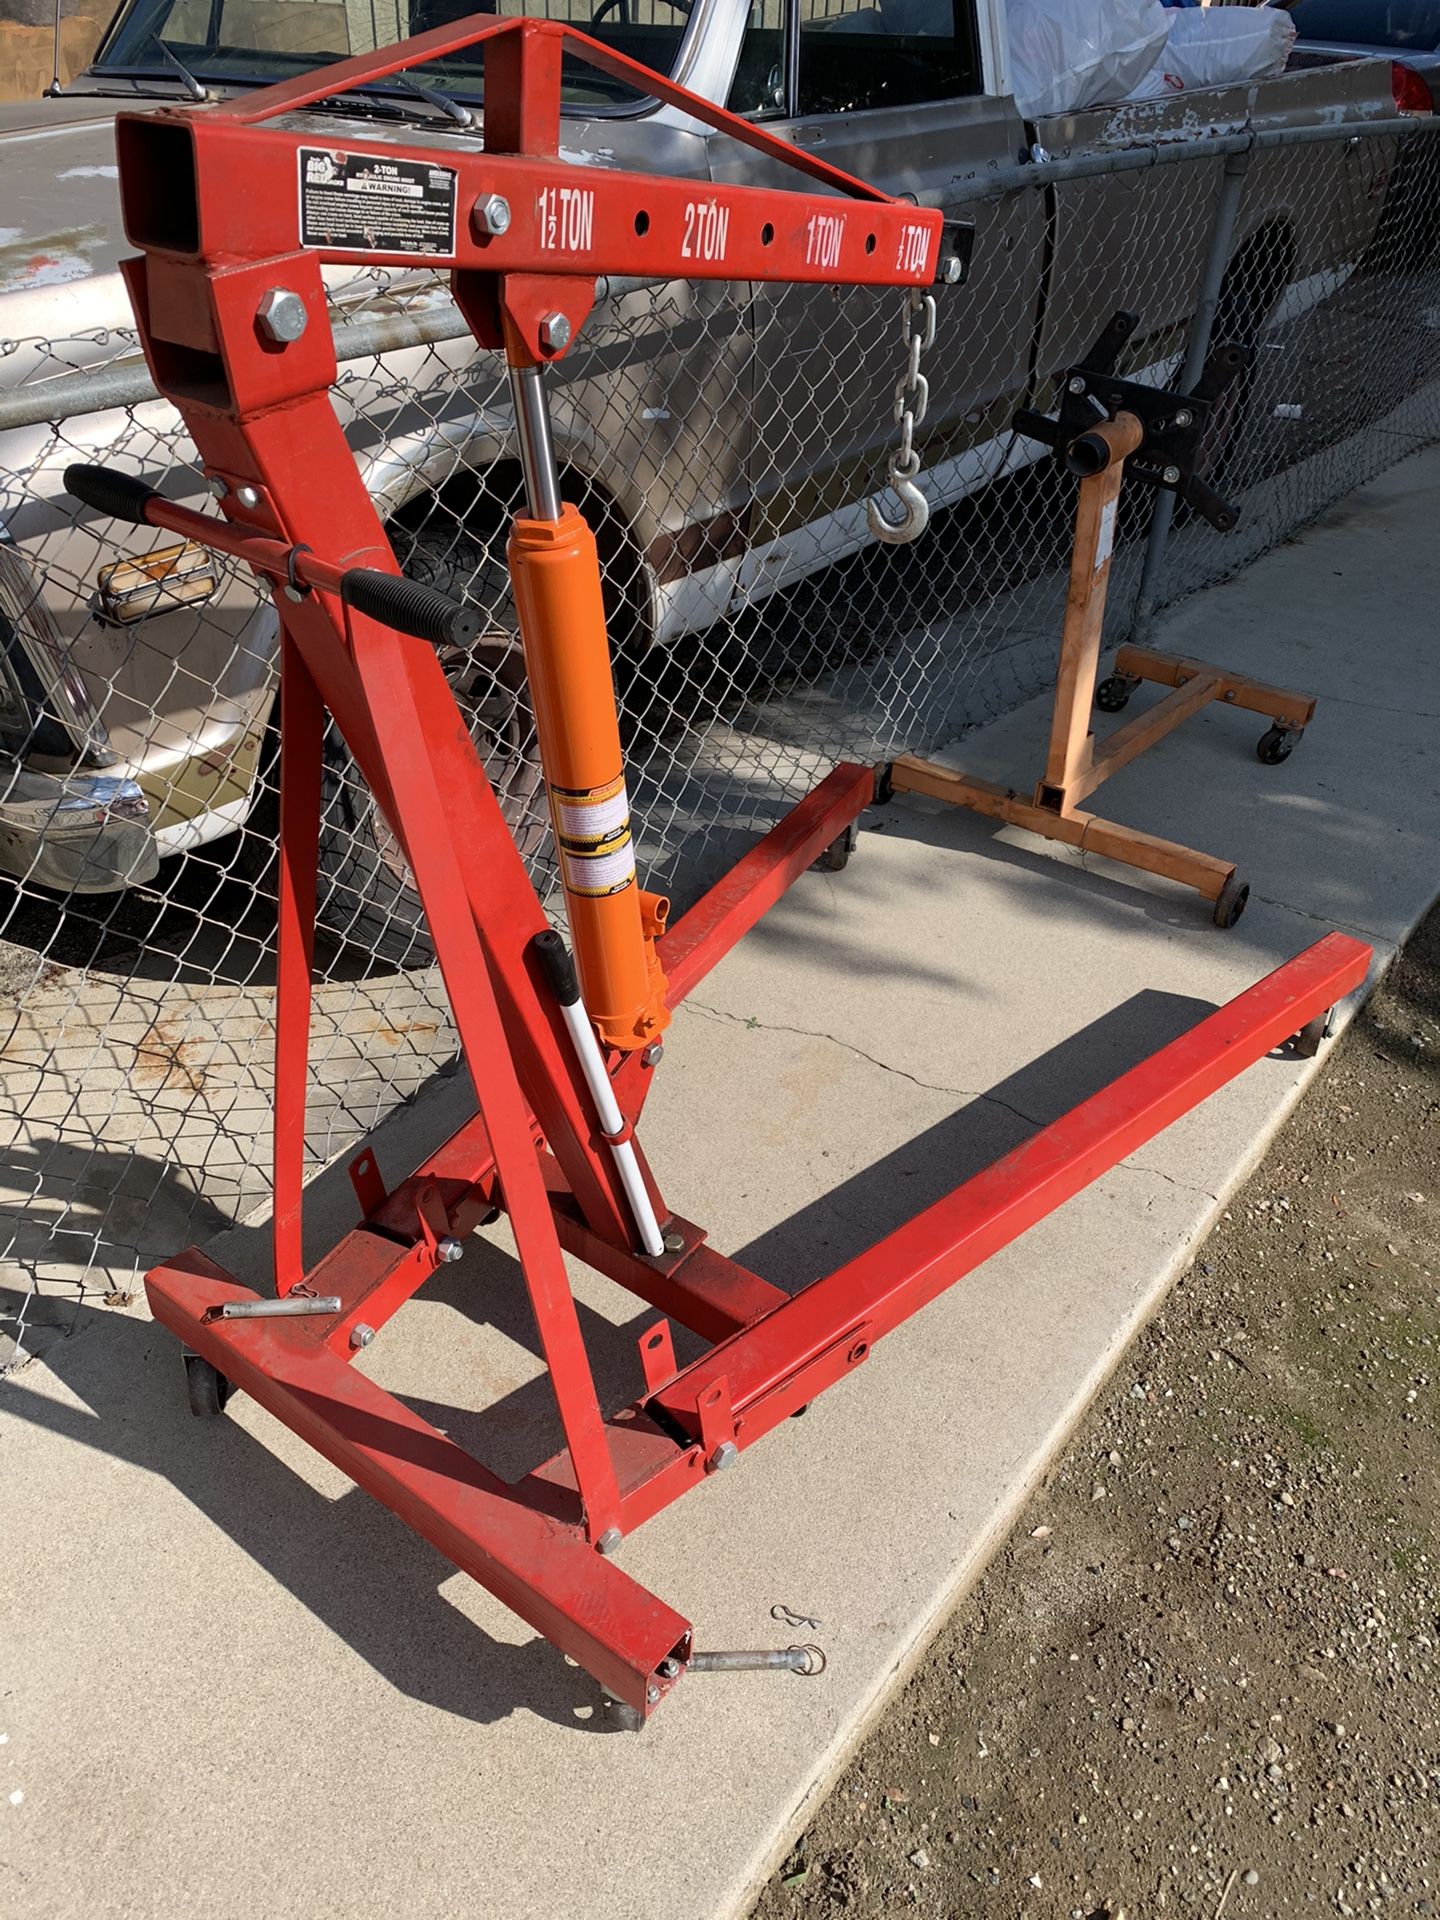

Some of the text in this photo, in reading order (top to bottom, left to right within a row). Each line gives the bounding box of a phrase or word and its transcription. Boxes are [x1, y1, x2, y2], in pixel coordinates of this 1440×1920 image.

[307, 160, 326, 173] BIG
[374, 164, 398, 176] 2-TON
[368, 182, 411, 194] WARNING!
